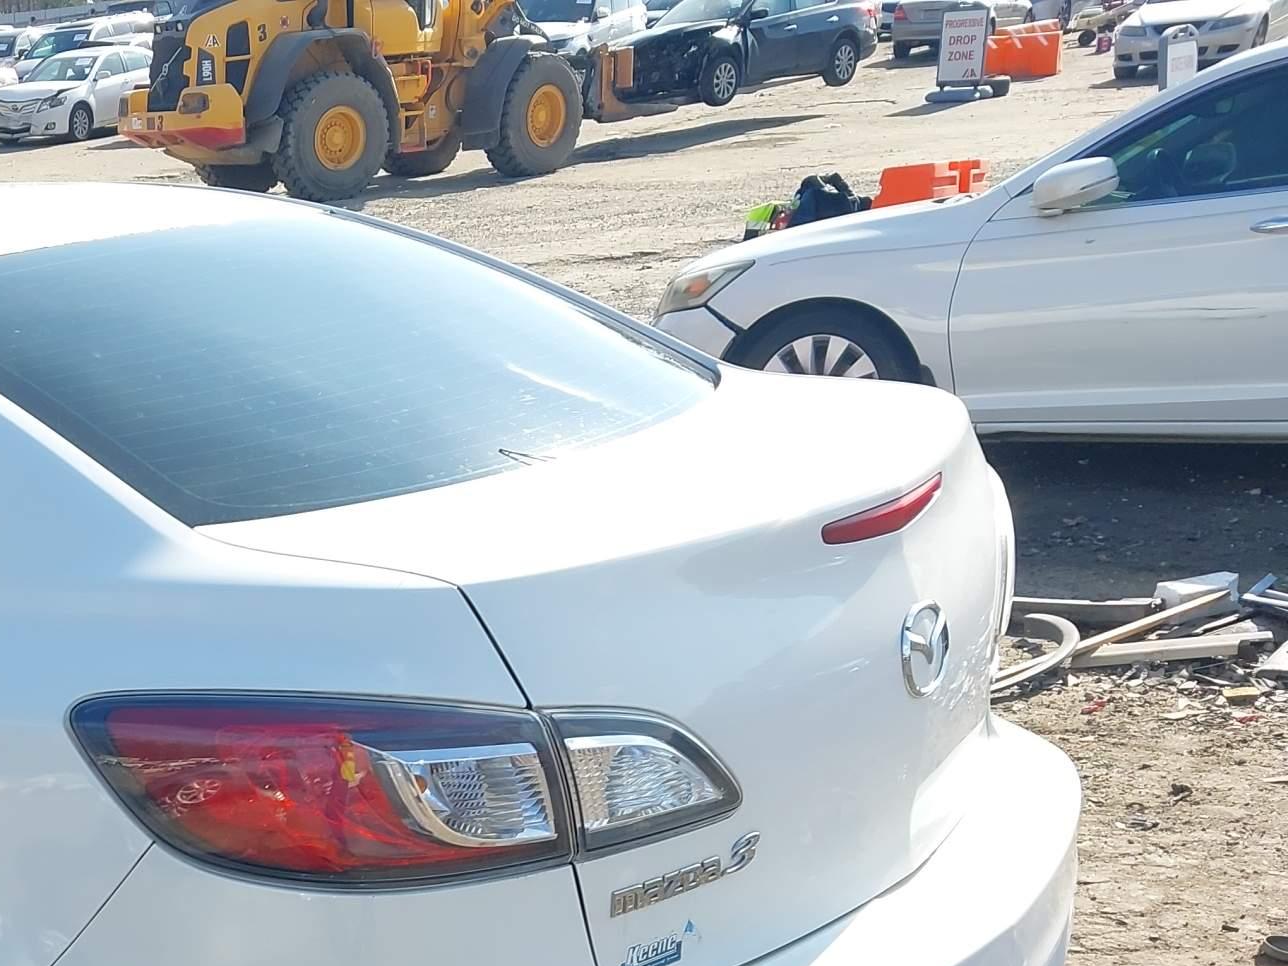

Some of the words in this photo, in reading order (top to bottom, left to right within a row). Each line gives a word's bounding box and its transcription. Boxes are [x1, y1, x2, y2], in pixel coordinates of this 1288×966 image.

[945, 17, 984, 28] PROGRESSIVE
[257, 24, 267, 41] 3
[948, 35, 977, 46] DROP
[948, 50, 974, 62] ZONE
